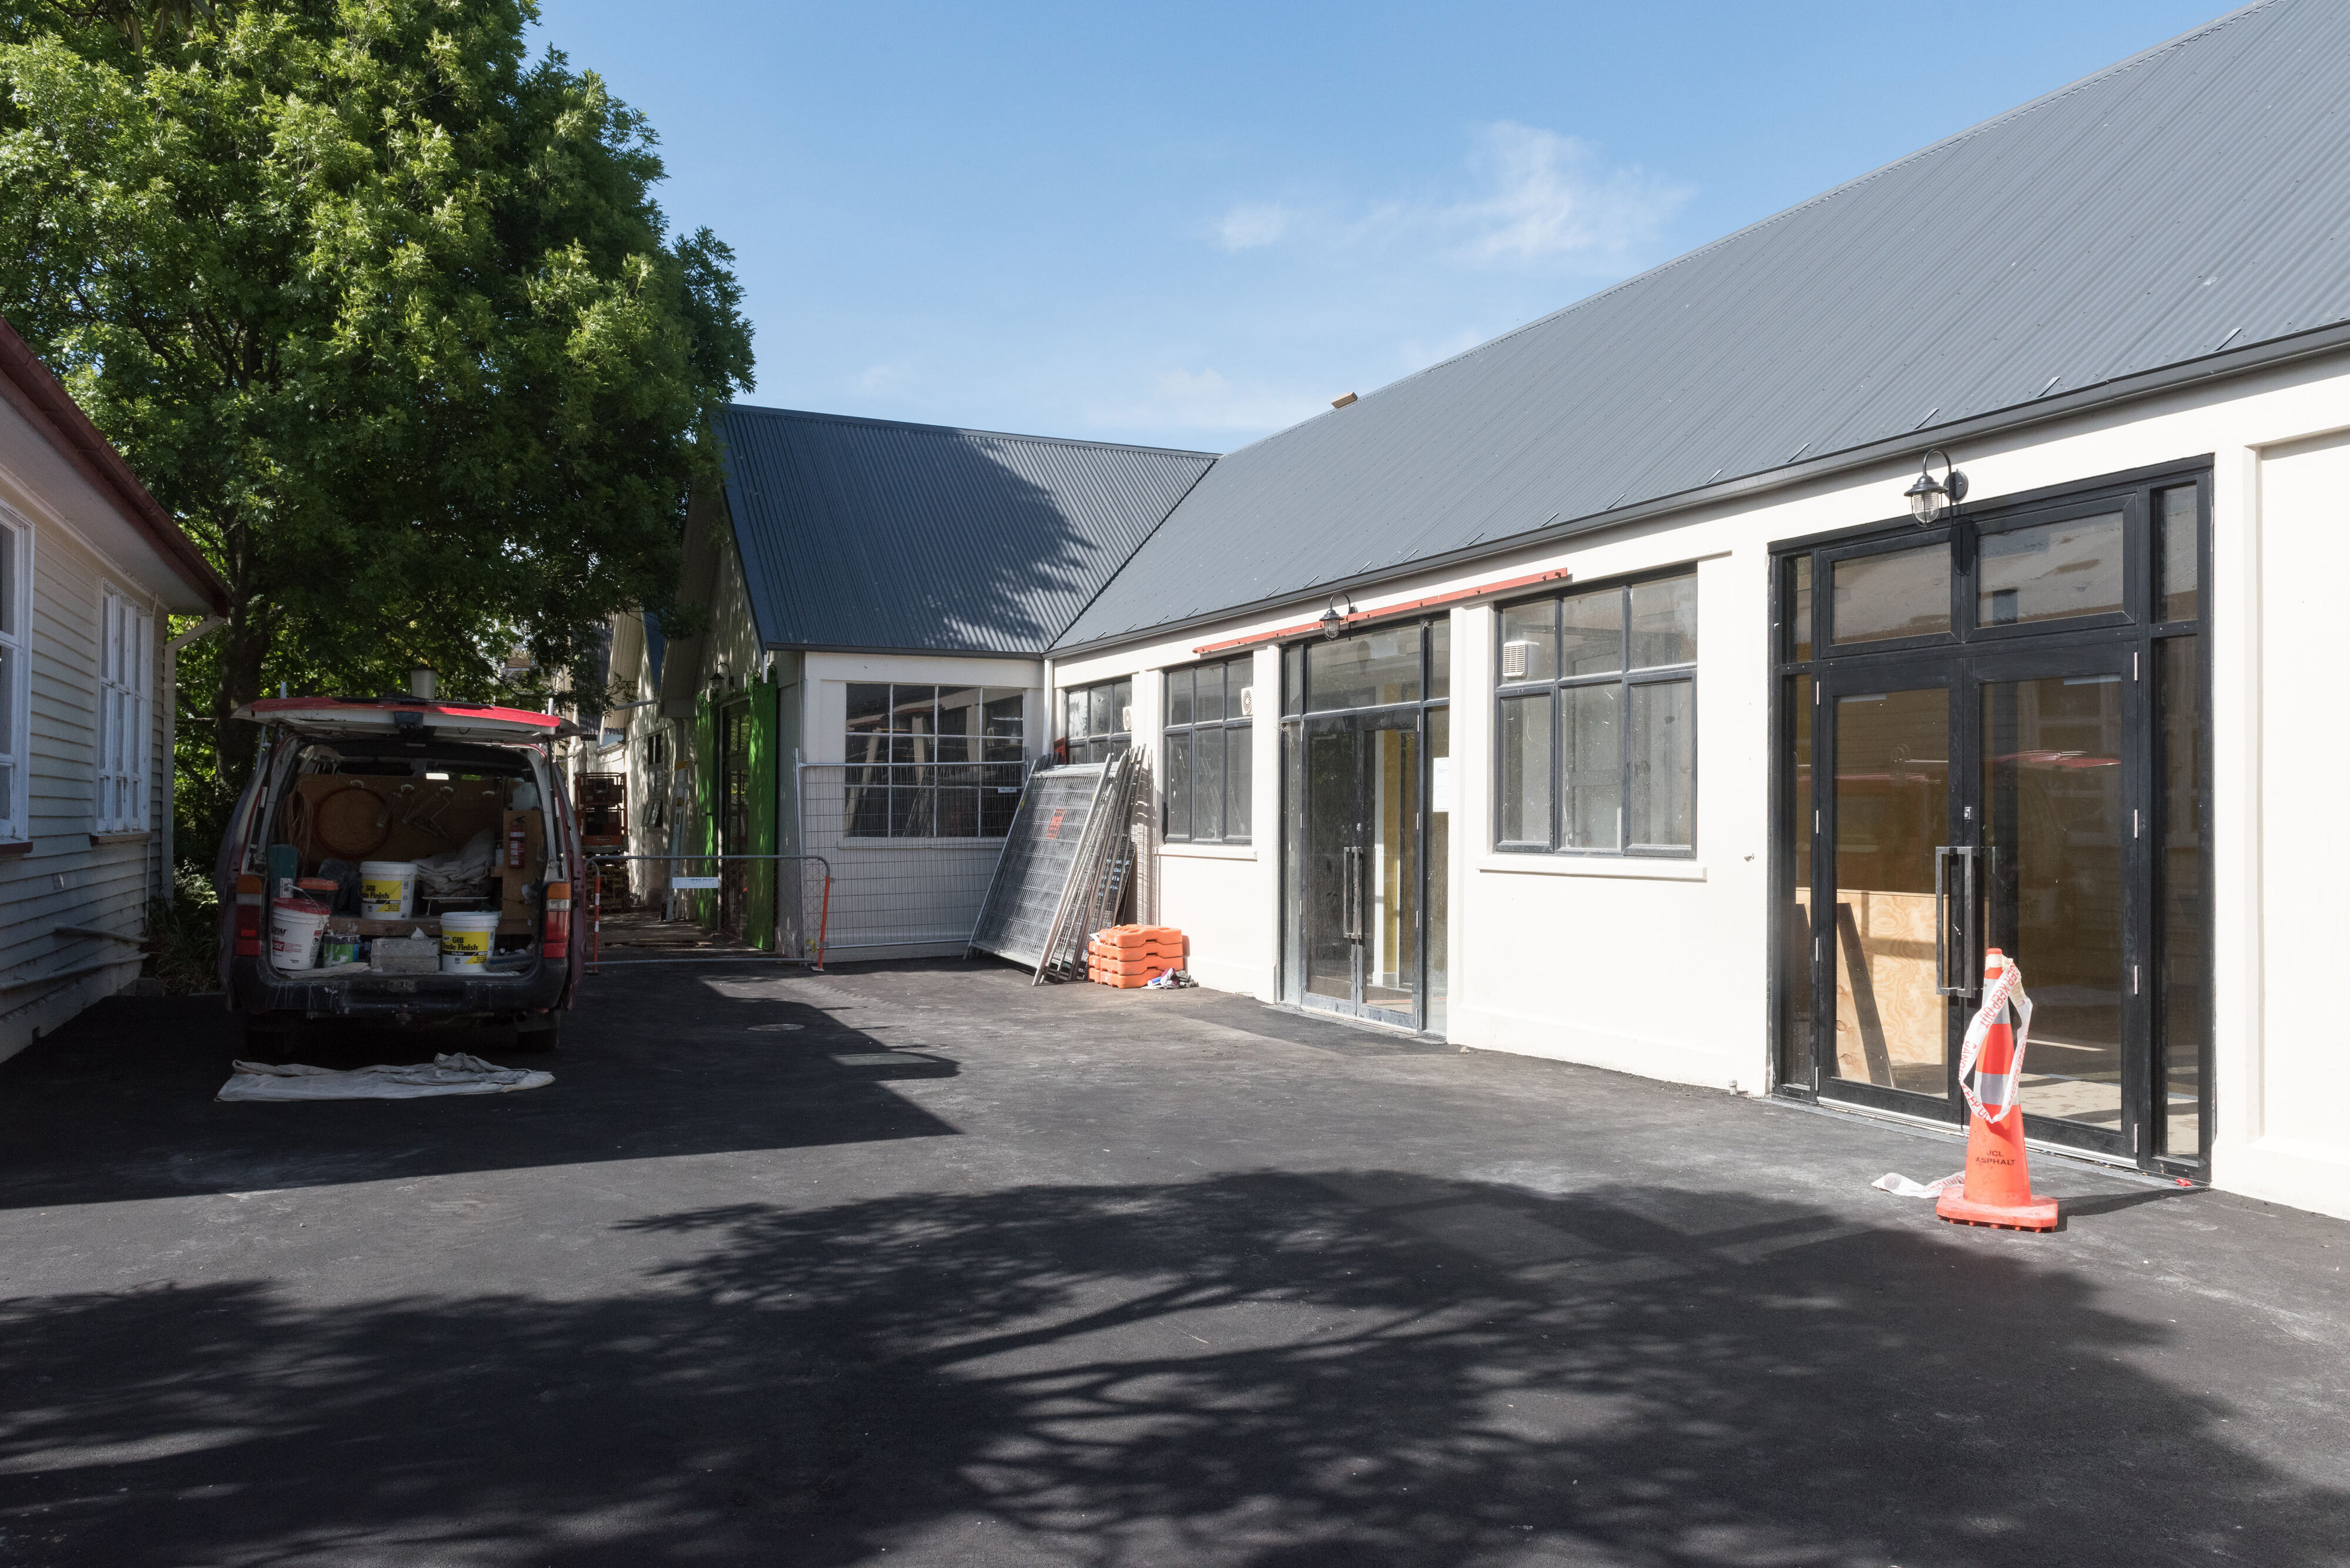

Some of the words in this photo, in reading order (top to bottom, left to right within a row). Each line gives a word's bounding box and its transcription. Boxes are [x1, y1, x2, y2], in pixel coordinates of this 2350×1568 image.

[272, 926, 287, 936] ORM
[1990, 983, 2010, 1010] KEEP
[1980, 1006, 1996, 1029] OUT
[1975, 1156, 2016, 1166] ASPHALT
